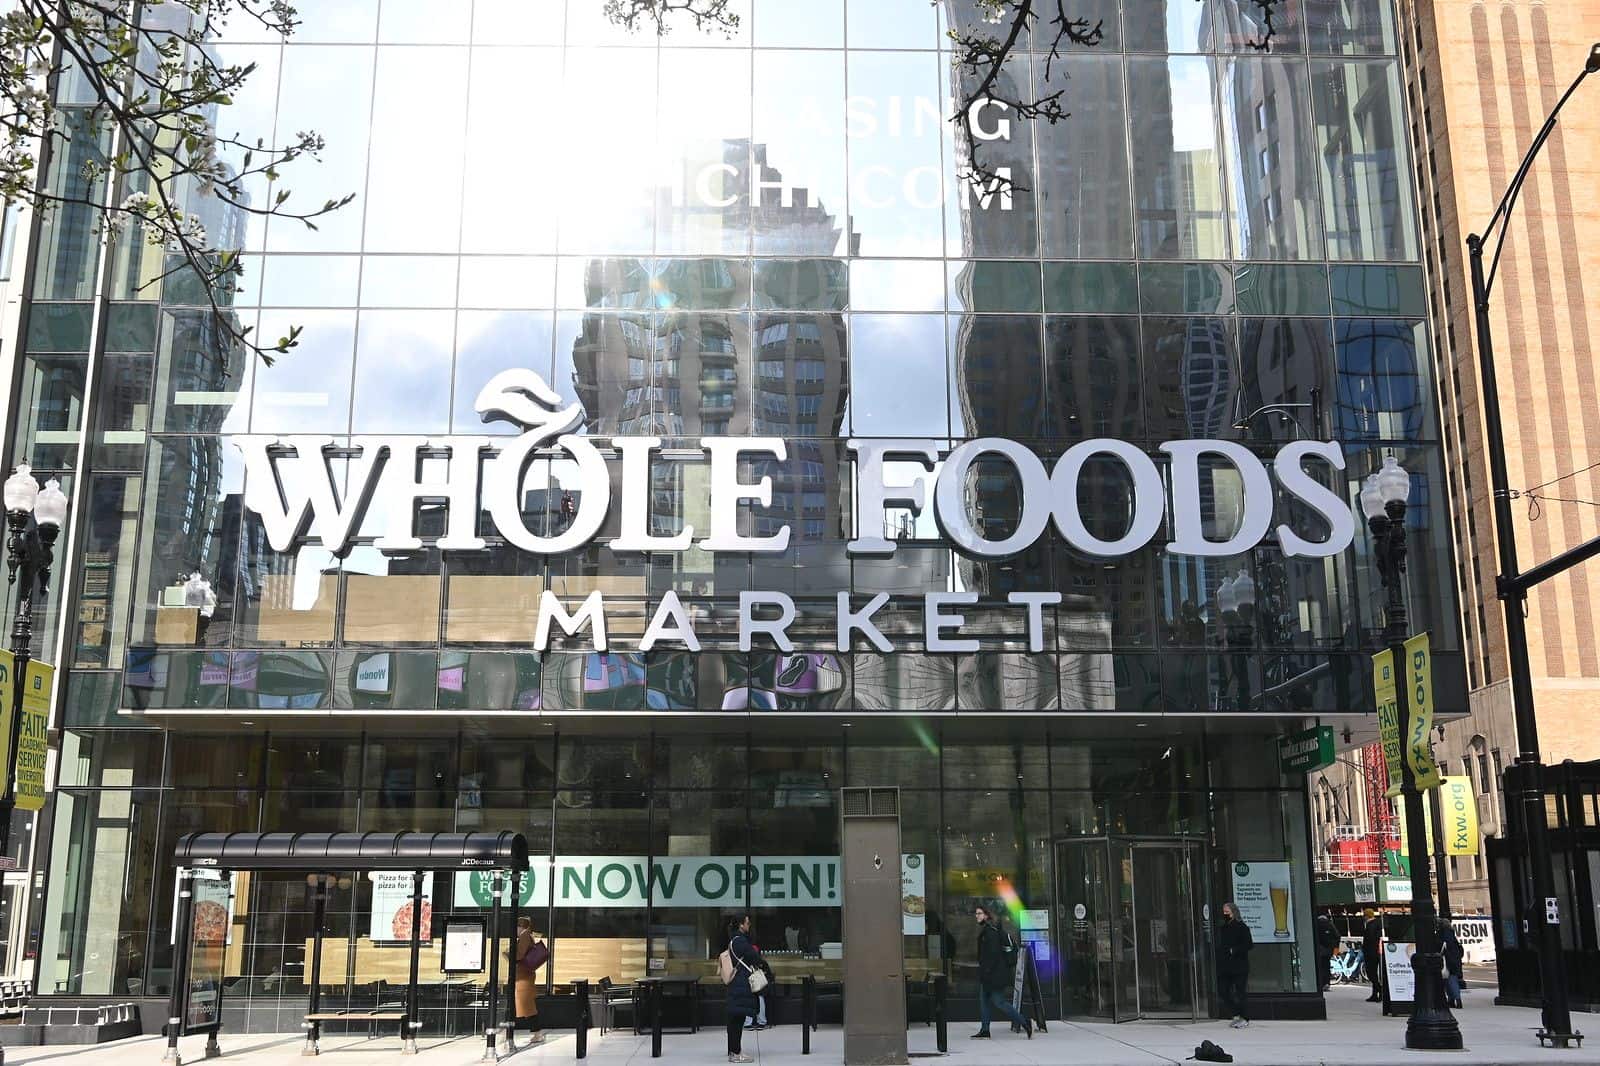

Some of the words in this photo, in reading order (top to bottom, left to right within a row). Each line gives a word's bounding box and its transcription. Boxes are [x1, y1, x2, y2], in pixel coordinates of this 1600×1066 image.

[234, 430, 790, 554] WHOLE
[846, 437, 1356, 557] FOODS
[534, 590, 1063, 653] MARKET
[20, 711, 49, 740] FAITH
[1377, 703, 1398, 730] FAIT
[1413, 650, 1430, 778] fxw.org
[18, 750, 48, 772] SERVICE
[1451, 784, 1468, 850] fxw.org
[378, 874, 396, 882] Pizza
[398, 874, 408, 882] for
[378, 882, 396, 890] pizza
[562, 863, 682, 900] NOW
[694, 863, 836, 900] OPEN!
